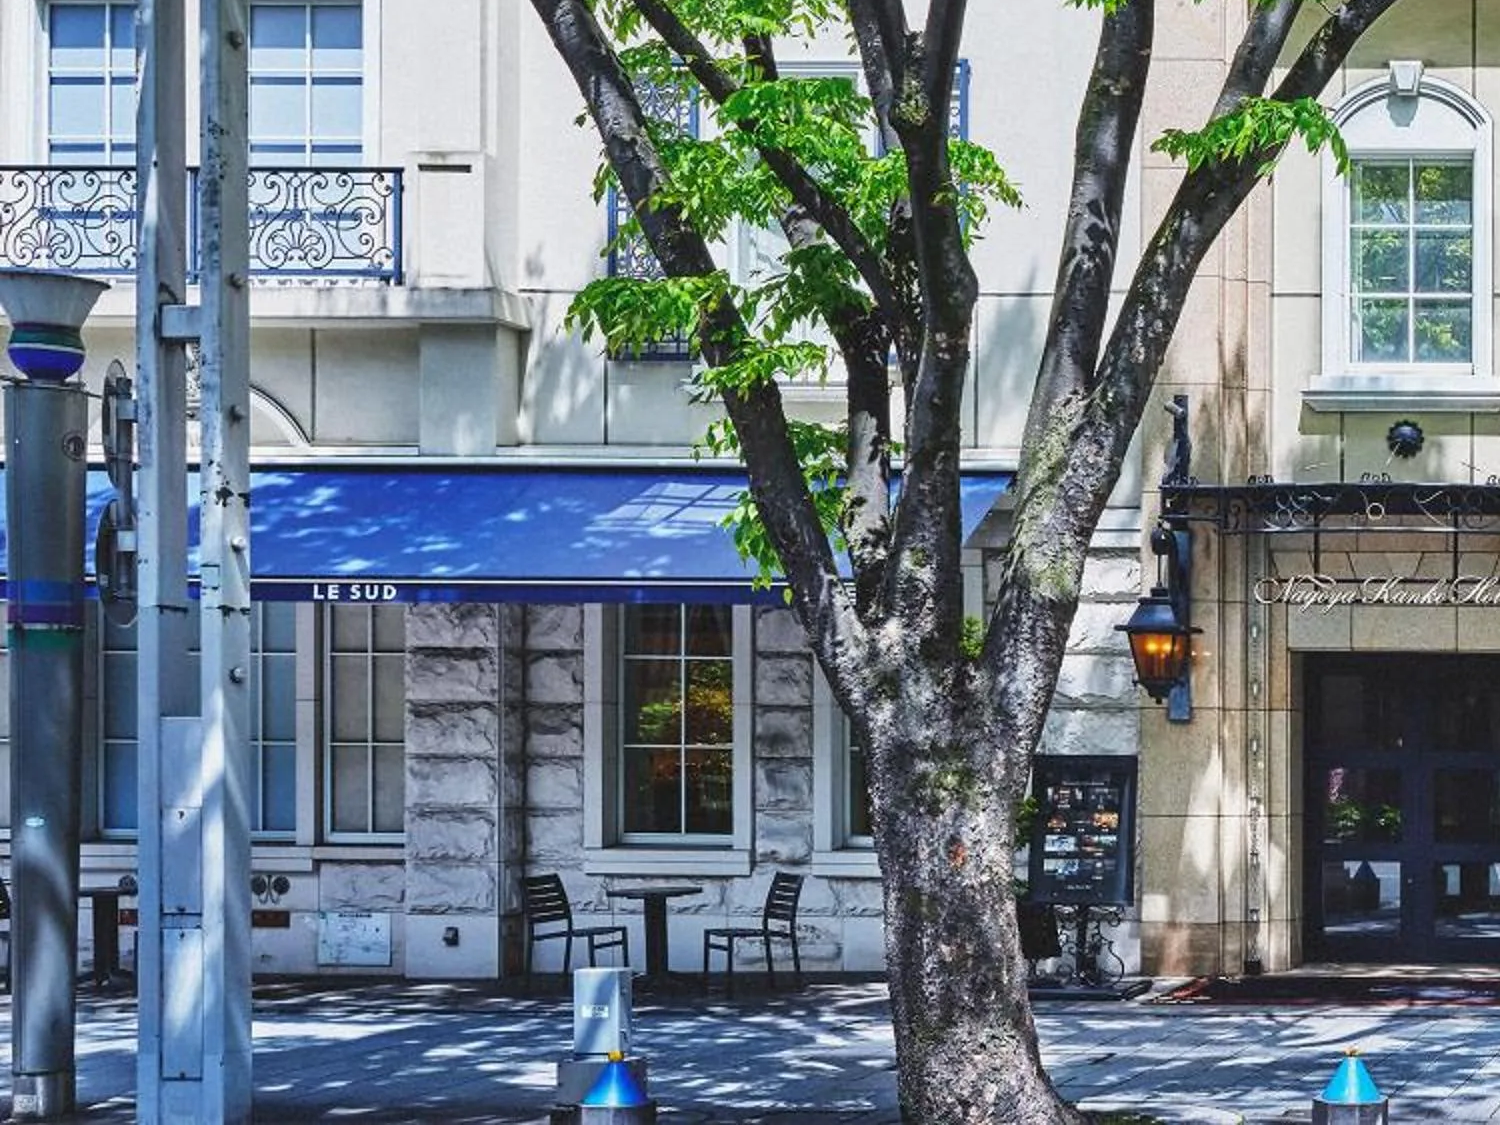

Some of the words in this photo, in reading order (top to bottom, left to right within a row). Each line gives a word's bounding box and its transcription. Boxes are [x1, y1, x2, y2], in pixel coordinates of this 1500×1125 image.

[313, 584, 339, 600] LE
[350, 584, 397, 600] SUD
[1254, 574, 1357, 615] Nagoya
[1361, 576, 1448, 604] Kanko
